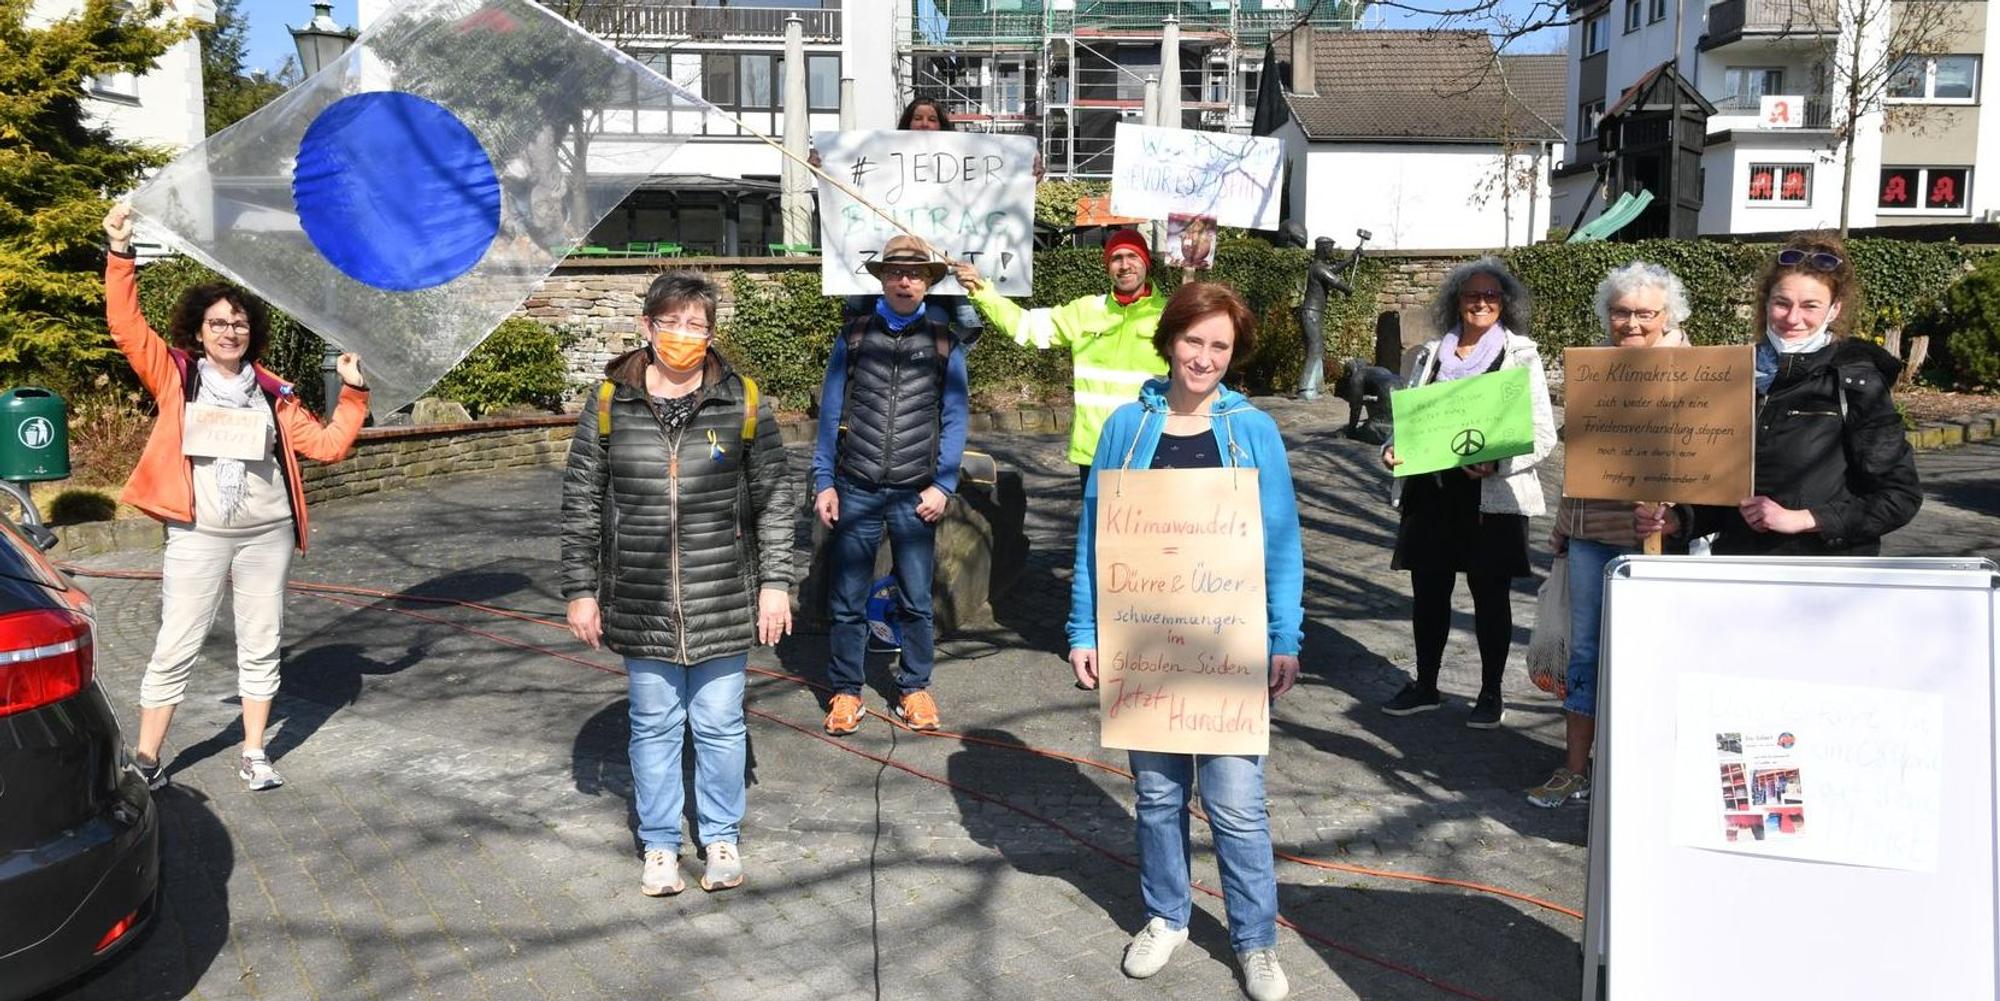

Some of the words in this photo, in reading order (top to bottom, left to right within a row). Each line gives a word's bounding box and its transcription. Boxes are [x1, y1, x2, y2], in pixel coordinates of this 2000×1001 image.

[885, 152, 1004, 205] JEDER
[841, 204, 1008, 236] BEITRAG
[1576, 364, 1600, 383] Die
[1605, 362, 1689, 384] Klimakrise
[1694, 364, 1733, 383] lässt
[1595, 395, 1617, 409] sich
[1623, 396, 1650, 409] weder
[1655, 397, 1686, 409] durch
[1688, 398, 1710, 409] eine
[1582, 415, 1694, 445] Friedensverhandlung
[1695, 423, 1735, 445] stoppen
[1105, 503, 1248, 537] Klimawandel:
[1107, 562, 1166, 594] Dürre
[1113, 605, 1246, 635] schwemmungen
[1167, 629, 1185, 646] im
[1191, 653, 1252, 676] Süden
[1108, 678, 1170, 719] Jetzt
[1168, 691, 1267, 736] Handeln!
